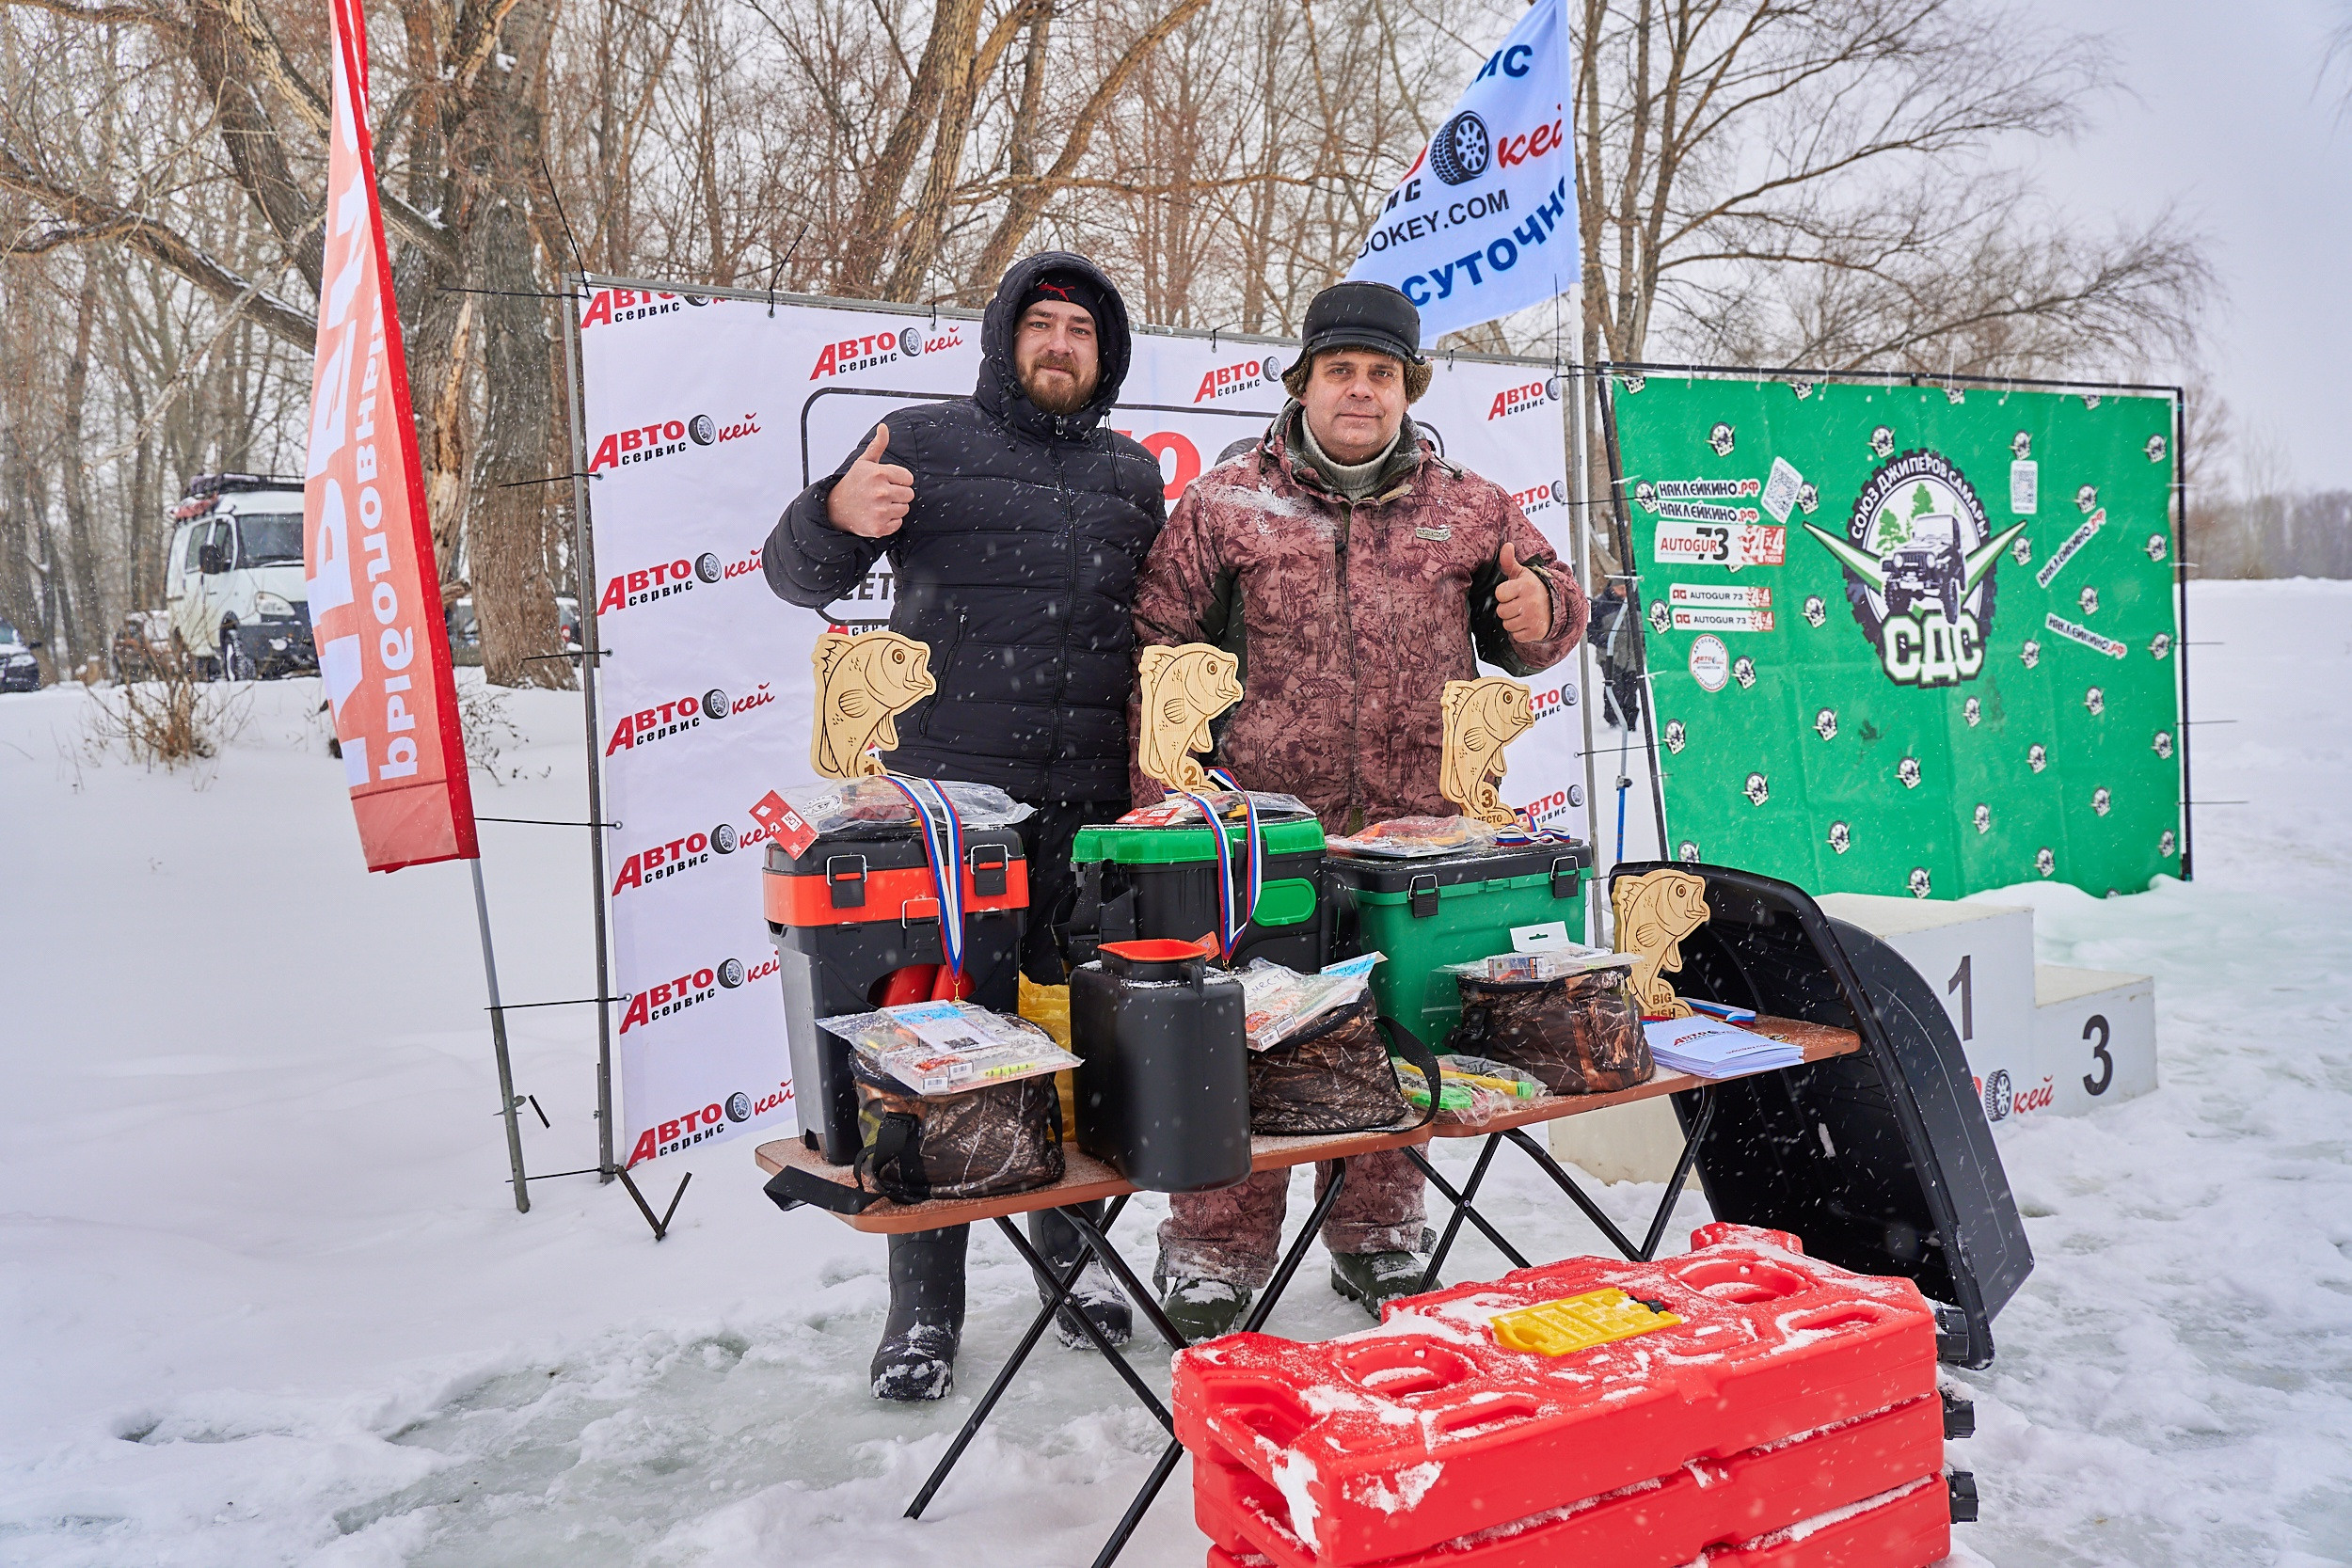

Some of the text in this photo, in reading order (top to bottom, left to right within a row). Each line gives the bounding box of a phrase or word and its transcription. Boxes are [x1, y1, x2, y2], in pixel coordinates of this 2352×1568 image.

[614, 301, 680, 323] сервис
[809, 326, 963, 380] АВТО кей
[838, 351, 898, 374] сервис
[1193, 360, 1261, 404] АВТО
[1217, 378, 1261, 397] сервис
[1487, 381, 1544, 420] АВТО
[1507, 398, 1545, 415] сервис
[588, 411, 761, 472] АВТО кей
[621, 440, 687, 467] сервис
[1511, 484, 1549, 508] ВТО
[1522, 499, 1550, 515] рвис
[1851, 455, 1989, 540] СОЮЗ ДЖИПЕРОВ САМАРЫ
[1661, 537, 1717, 553] AUTOGUR
[1696, 527, 1730, 562] 73
[596, 559, 691, 615] АВТО
[628, 579, 694, 608] сервис
[840, 572, 895, 600] ЕТ
[1690, 592, 1731, 600] AUTOGUR
[1693, 616, 1734, 625] AUTOGUR
[1883, 613, 1984, 683] СДС
[605, 682, 776, 757] АВТО кей
[1534, 705, 1561, 721] рвис
[636, 716, 701, 746] сервис
[1184, 766, 1198, 786] 2
[1481, 789, 1493, 808] 3
[1520, 791, 1565, 820] ВТО
[1537, 806, 1566, 824] рвис
[612, 832, 707, 896] АВТО
[644, 852, 709, 884] сервис
[620, 968, 714, 1035] АВТО
[651, 987, 716, 1022] сервис
[1653, 992, 1672, 1006] BIG
[1947, 954, 1974, 1041] 1
[2082, 1014, 2114, 1096] 3
[2013, 1075, 2054, 1115] кей
[626, 1103, 723, 1169] АВТО
[659, 1122, 724, 1157] сервис
